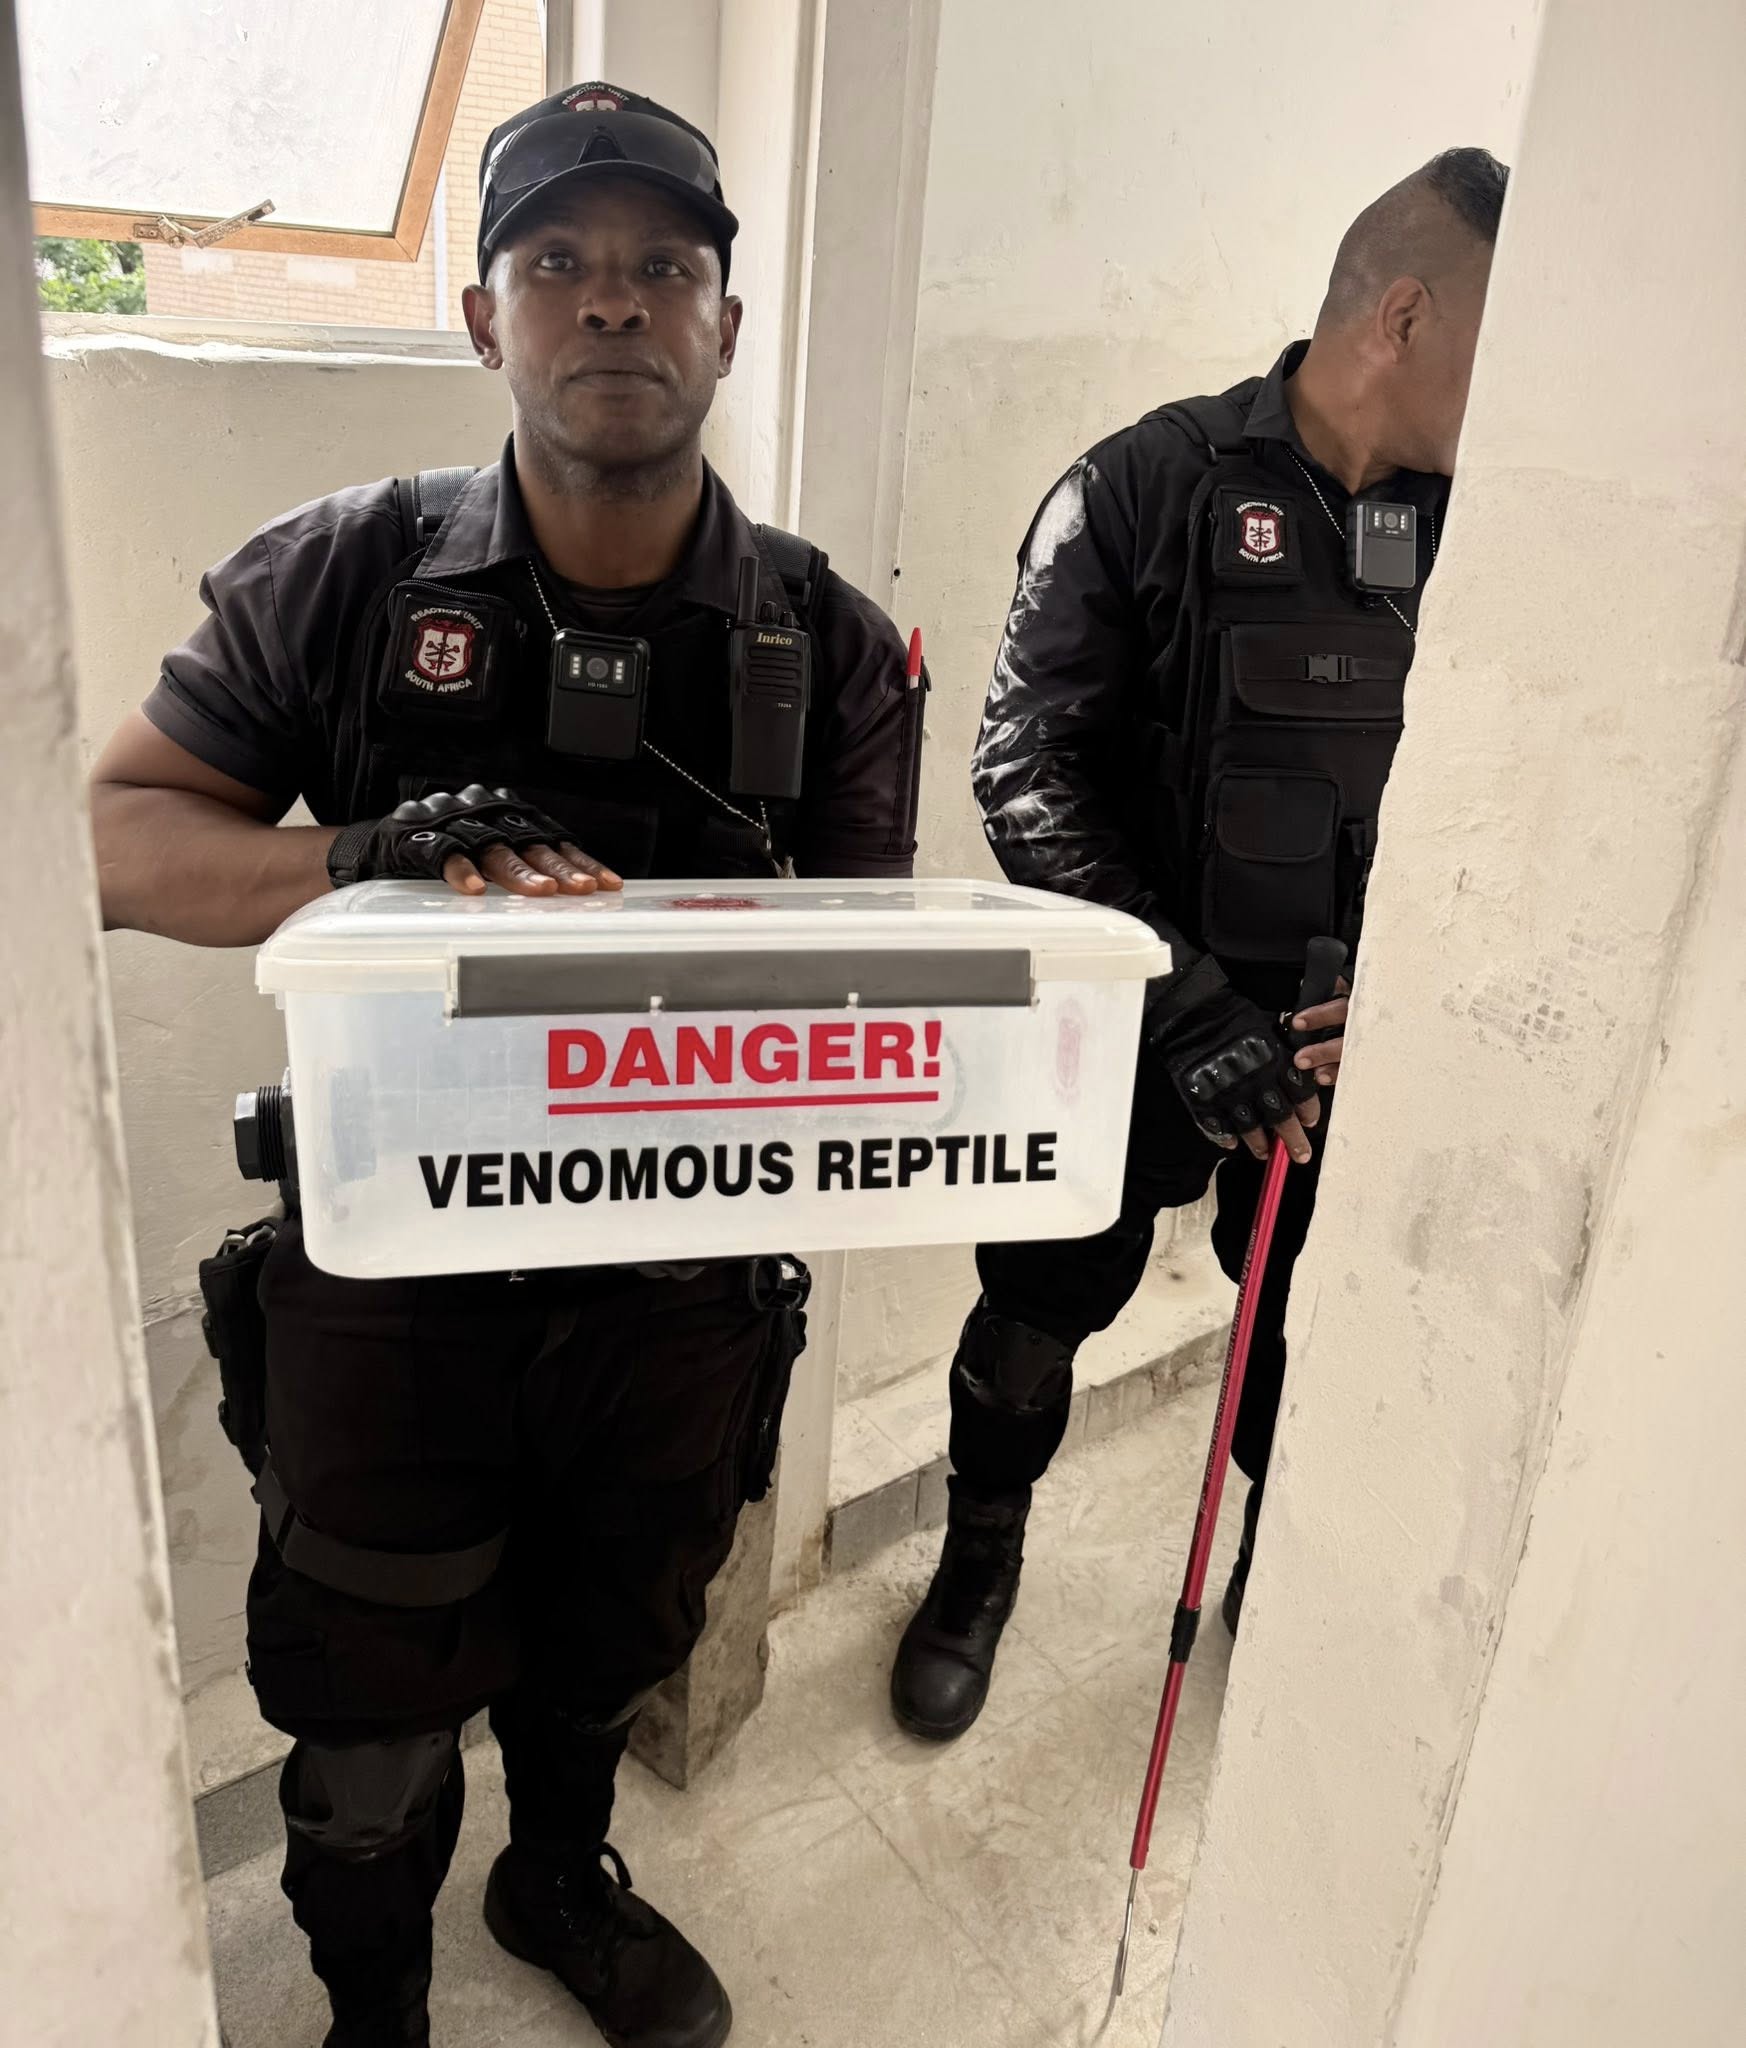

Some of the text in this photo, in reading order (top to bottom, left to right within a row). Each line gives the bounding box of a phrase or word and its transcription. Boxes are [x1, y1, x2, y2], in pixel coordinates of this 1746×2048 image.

[561, 84, 631, 106] REACTION UNIT
[1235, 501, 1285, 516] REACTION UNIT
[1238, 548, 1285, 564] SOUTH AFRICA
[410, 607, 485, 630] REACTION UNIT
[756, 632, 793, 646] Inrico
[404, 669, 473, 693] SOUTH AFRICA
[548, 1021, 942, 1089] DANGER!
[419, 1133, 1056, 1208] VENOMOUS REPTILE
